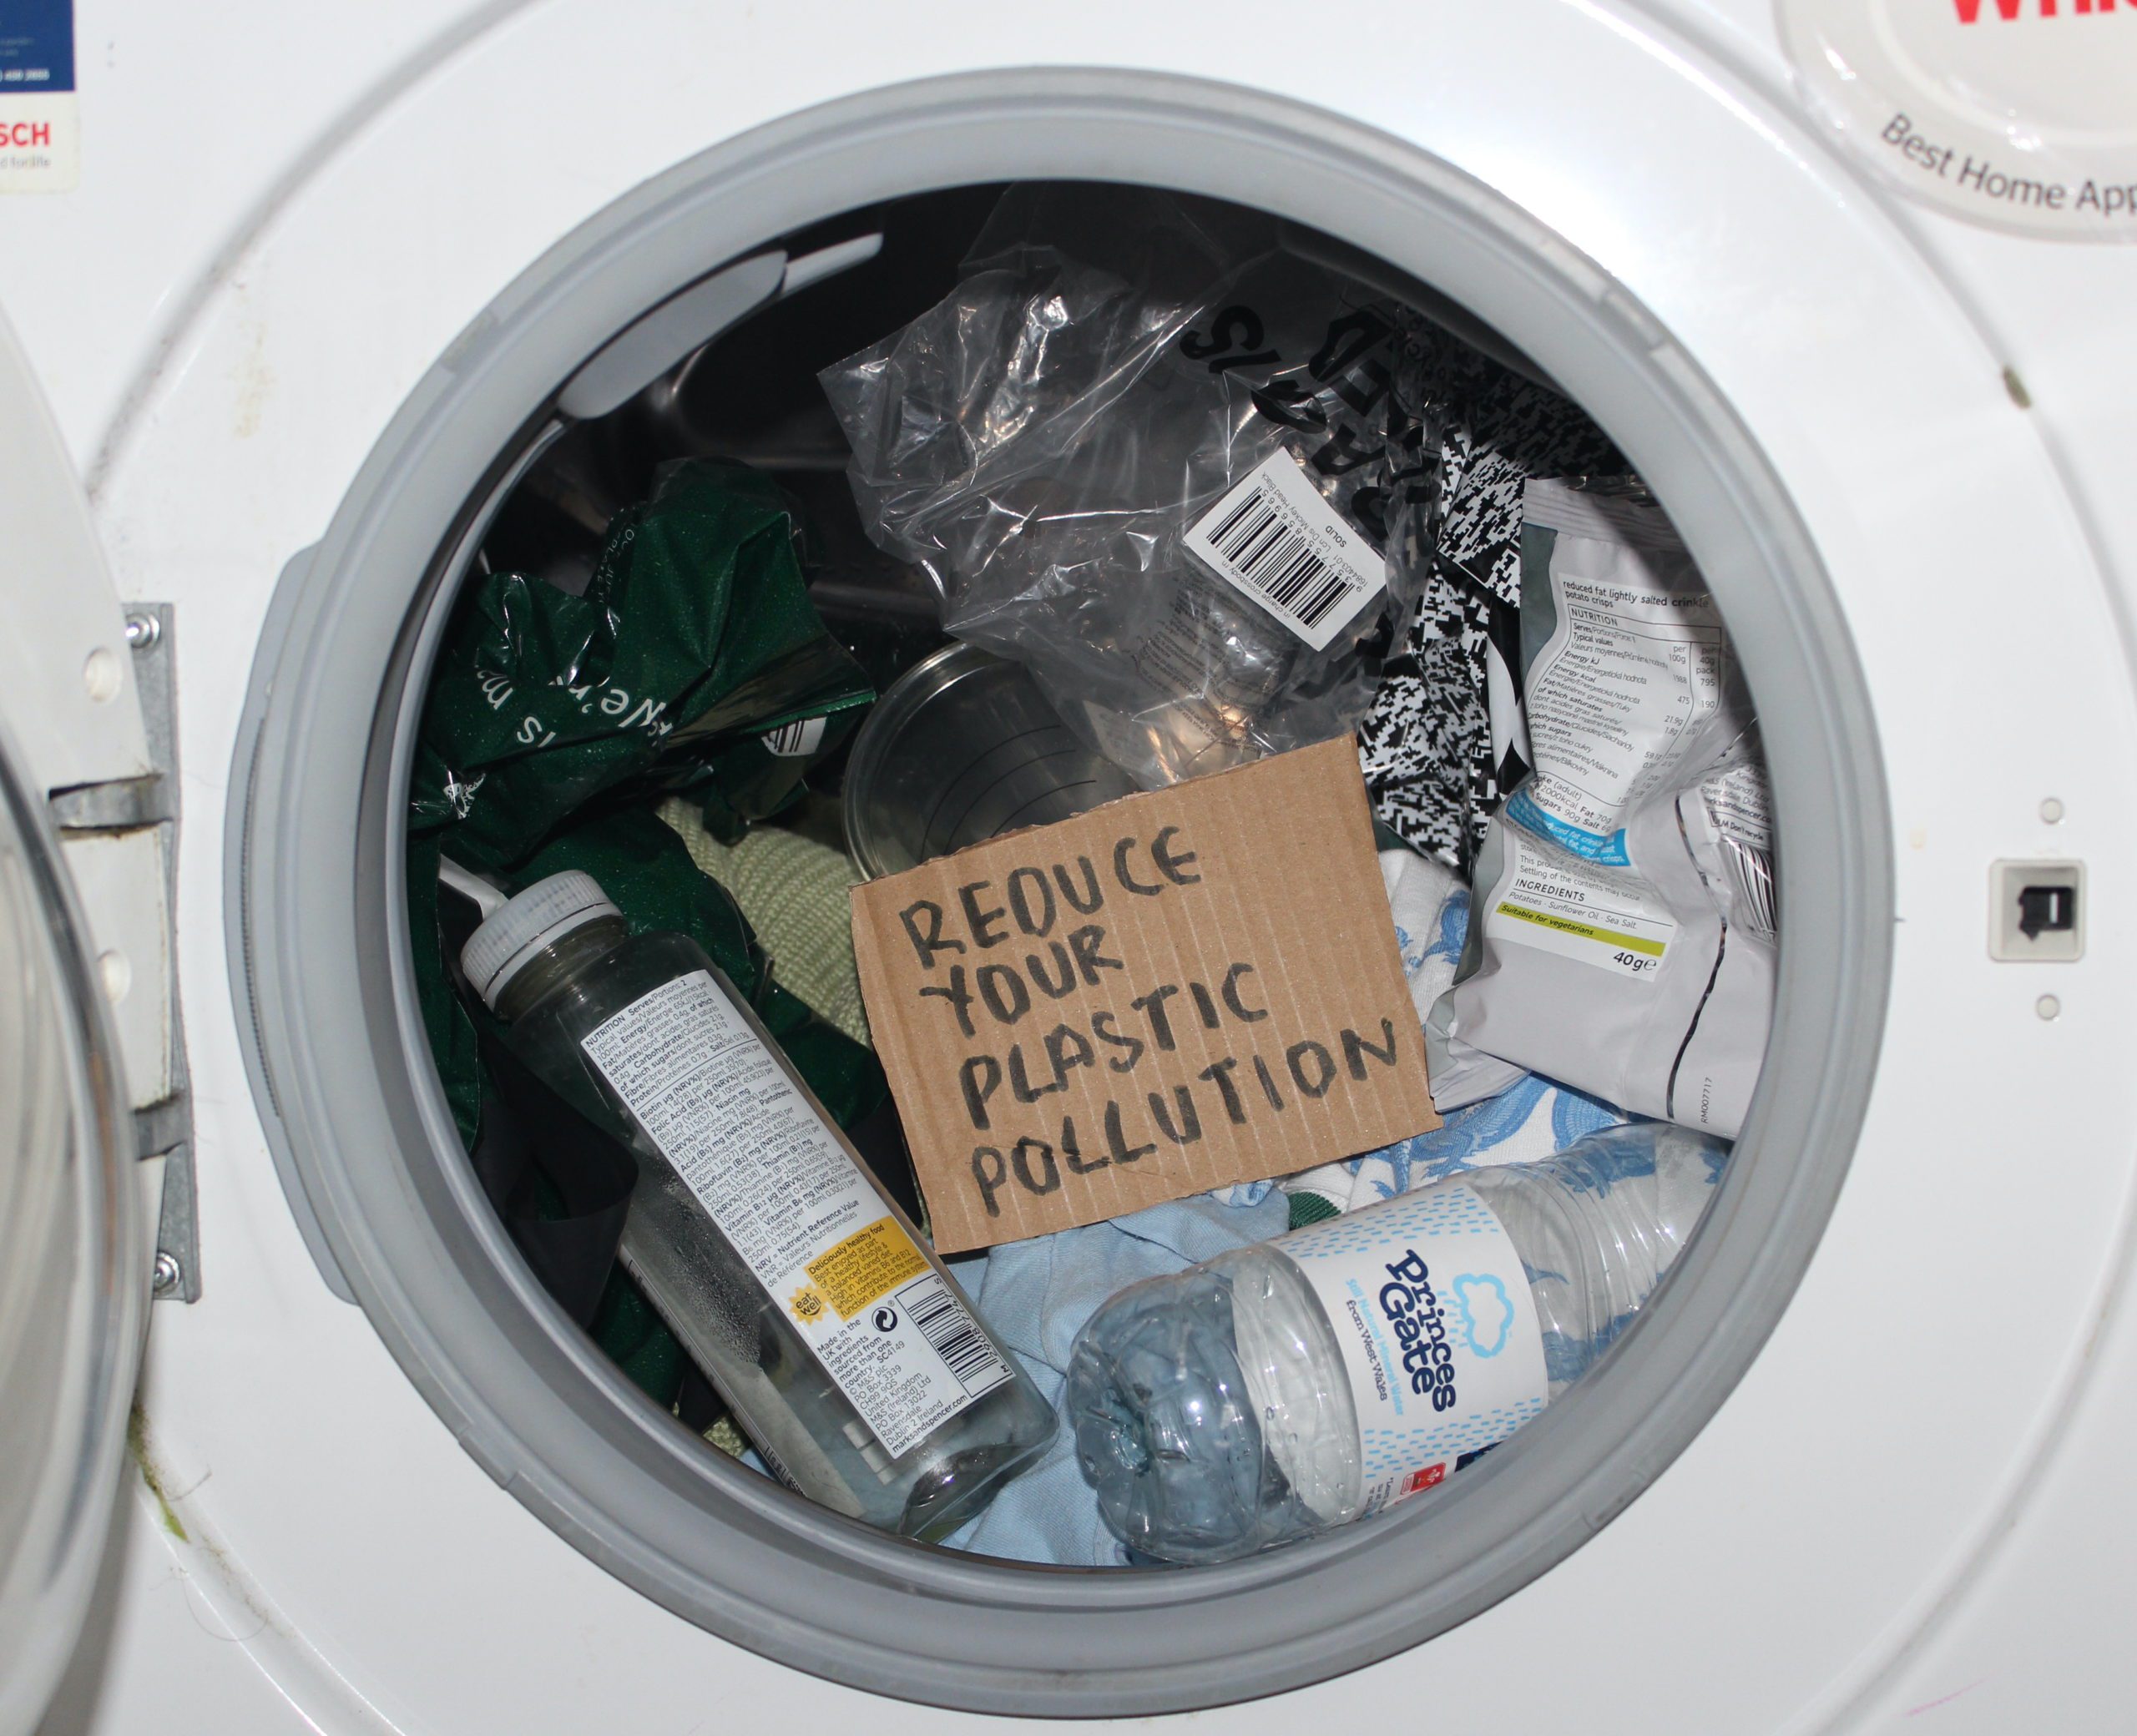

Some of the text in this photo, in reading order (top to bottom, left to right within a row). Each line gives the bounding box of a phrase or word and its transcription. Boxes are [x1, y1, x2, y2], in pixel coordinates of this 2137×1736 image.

[1882, 113, 1954, 178] Best
[1958, 155, 2067, 209] Home
[1260, 471, 1276, 492] Black
[1272, 488, 1291, 509] Head
[1287, 505, 1309, 531] Mickey
[1324, 524, 1346, 548] SOLID
[1228, 563, 1261, 595] crossbody
[1332, 553, 1368, 591] 1684403-01
[1263, 588, 1283, 609] charge
[1562, 580, 1593, 593] reduced
[1594, 585, 1607, 597] fat
[1608, 588, 1638, 604] lightly
[1640, 594, 1669, 606] salted
[1564, 590, 1614, 608] potato crisps
[1569, 607, 1618, 626] NUTRITION
[1573, 631, 1594, 643] Typical
[1594, 637, 1614, 647] values
[1672, 645, 1687, 654] per
[1552, 663, 1597, 684] Energy kcal
[1562, 649, 1600, 665] Energy kJ
[1668, 653, 1686, 664] 100g
[1676, 694, 1690, 704] 475
[1700, 677, 1716, 689] 795
[1532, 694, 1549, 702] dont
[1550, 698, 1574, 709] acides
[1546, 689, 1568, 704] which
[1569, 696, 1604, 712] saturates
[1700, 699, 1716, 710] 190
[1550, 780, 1584, 801] (adult)
[1532, 791, 1564, 812] Sugars
[1563, 808, 1581, 824] 90g
[1582, 818, 1599, 830] Salt
[1579, 805, 1594, 818] Fat
[1514, 877, 1585, 906] INGREDIENTS
[1518, 864, 1548, 880] Settling
[1548, 871, 1559, 880] of
[1559, 874, 1572, 884] the
[1573, 874, 1605, 891] contents
[899, 825, 1202, 971] REDUCE
[1508, 891, 1542, 906] Potatoes
[1547, 901, 1592, 918] Sunflower
[1591, 911, 1599, 920] Oil
[1604, 914, 1619, 925] Sea
[1500, 904, 1594, 936] Suitable for vegetarians
[919, 923, 1124, 1039] YOUR
[584, 1014, 625, 1047] NUTRITION
[589, 1032, 618, 1054] Typical
[616, 999, 668, 1035] values/Valeurs
[666, 984, 700, 1003] moyennes
[958, 962, 1269, 1131] PLASTIC
[1700, 1077, 1712, 1124] RM007717
[972, 1017, 1401, 1218] POLLUTION
[754, 1199, 860, 1272] NRV Nutrient Reference Value
[760, 1210, 857, 1279] VNR Valeurs Nutritionnelles
[807, 1223, 885, 1274] Deliciously healthy food
[766, 1249, 814, 1288] de Référence
[813, 1237, 879, 1283] Best enjoyed as part
[795, 1291, 814, 1310] eat
[797, 1294, 821, 1315] well
[816, 1319, 861, 1354] Made in the
[1346, 1278, 1403, 1416] Still Natural Mineral Water
[1379, 1281, 1436, 1395] Gate
[1385, 1249, 1457, 1412] Princes
[821, 1336, 852, 1360] UK with
[826, 1335, 869, 1368] ingredients
[833, 1335, 882, 1375] sourced from
[838, 1340, 892, 1382] more than one
[1345, 1299, 1387, 1401] from West Wales
[844, 1340, 905, 1391] country. SC4149
[856, 1373, 875, 1390] M&S
[874, 1364, 888, 1378] plc
[853, 1364, 902, 1403] PO Box 3339
[859, 1377, 897, 1410] CH99 9QS
[864, 1371, 922, 1417] United Kingdom
[869, 1374, 932, 1425] M&S (Ireland) Ltd
[874, 1389, 927, 1431] PO Box 13022
[885, 1398, 943, 1446] Dublin 2 Ireland
[891, 1394, 968, 1453] marksandspencer.com
